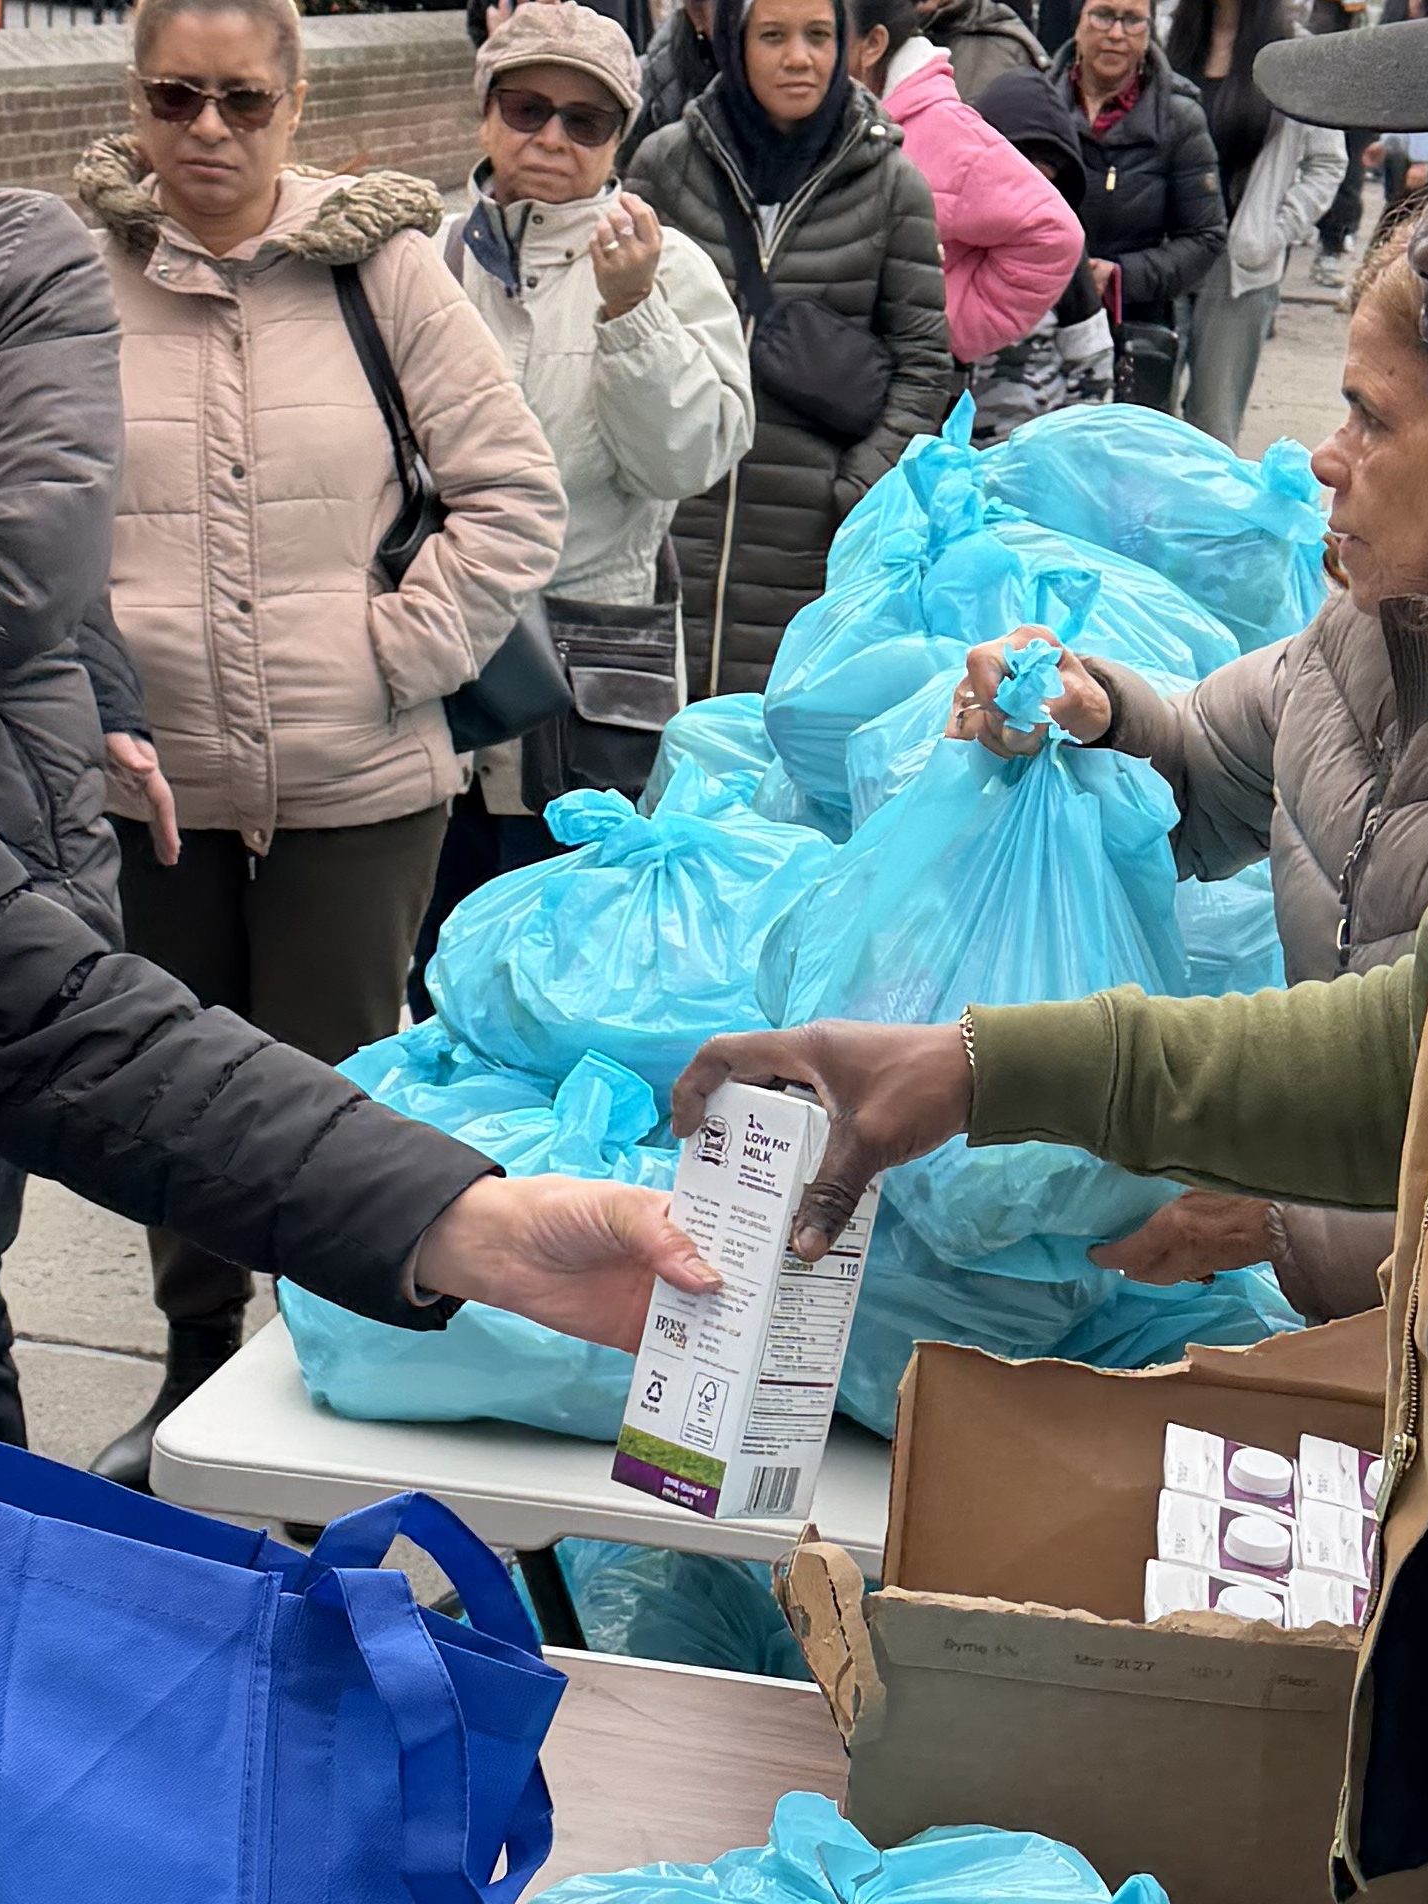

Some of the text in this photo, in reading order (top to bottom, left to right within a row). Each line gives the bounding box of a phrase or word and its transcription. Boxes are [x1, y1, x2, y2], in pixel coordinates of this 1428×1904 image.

[745, 1130, 771, 1147] LOW
[743, 1144, 773, 1164] MILK
[840, 1262, 859, 1276] 110
